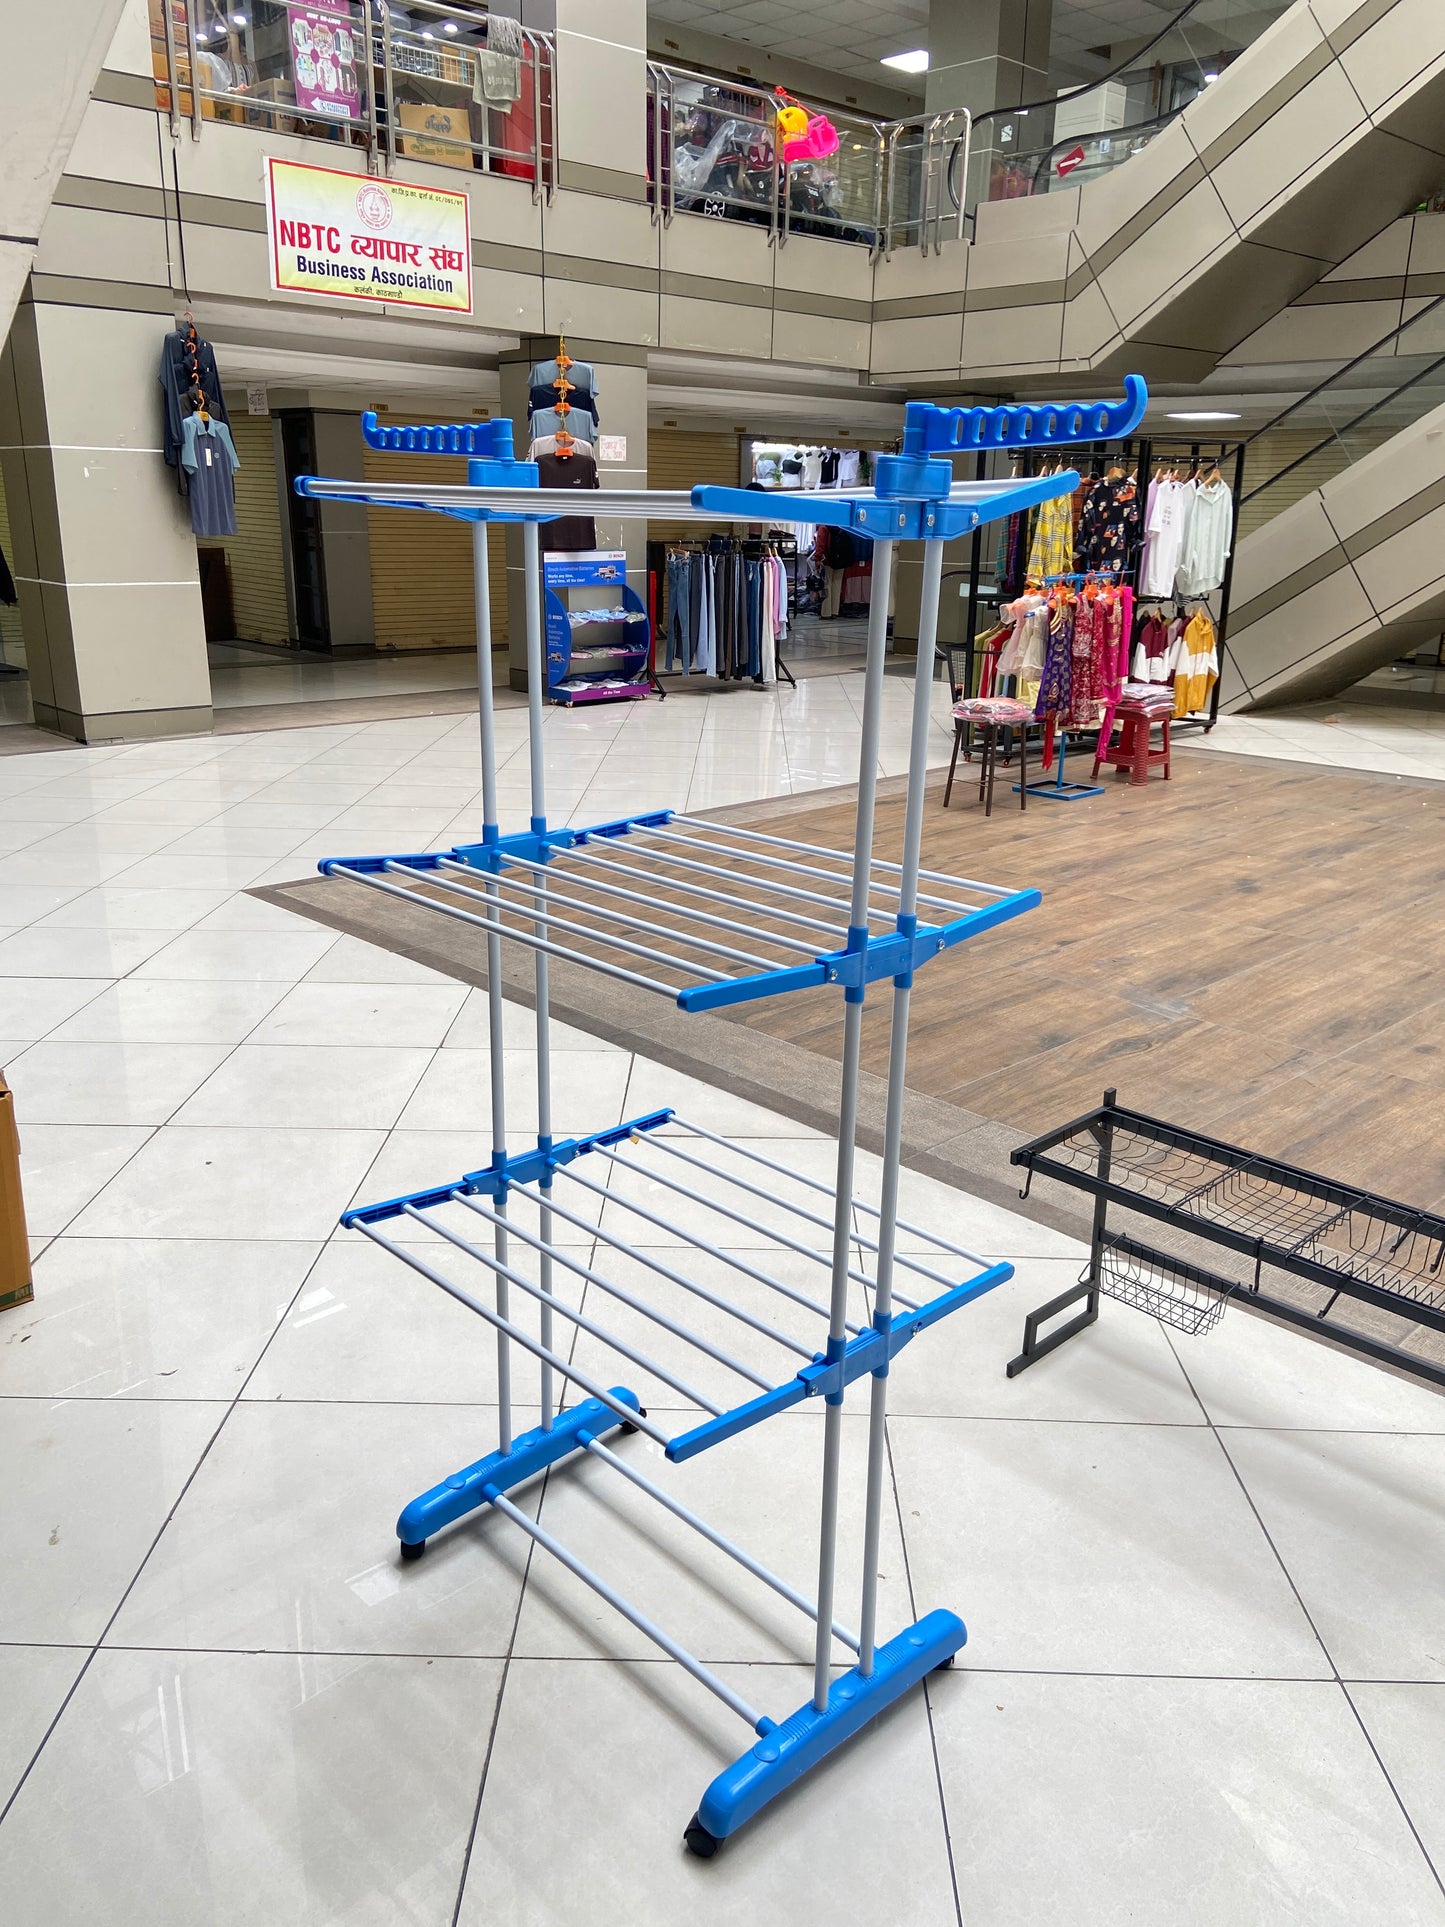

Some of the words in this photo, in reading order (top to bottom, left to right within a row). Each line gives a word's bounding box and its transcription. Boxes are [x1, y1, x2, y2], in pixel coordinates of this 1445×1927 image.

[280, 219, 341, 254] NBTC
[350, 234, 423, 267] व्यापार
[428, 244, 464, 272] संघ
[296, 255, 366, 281] Business
[371, 266, 453, 293] Association
